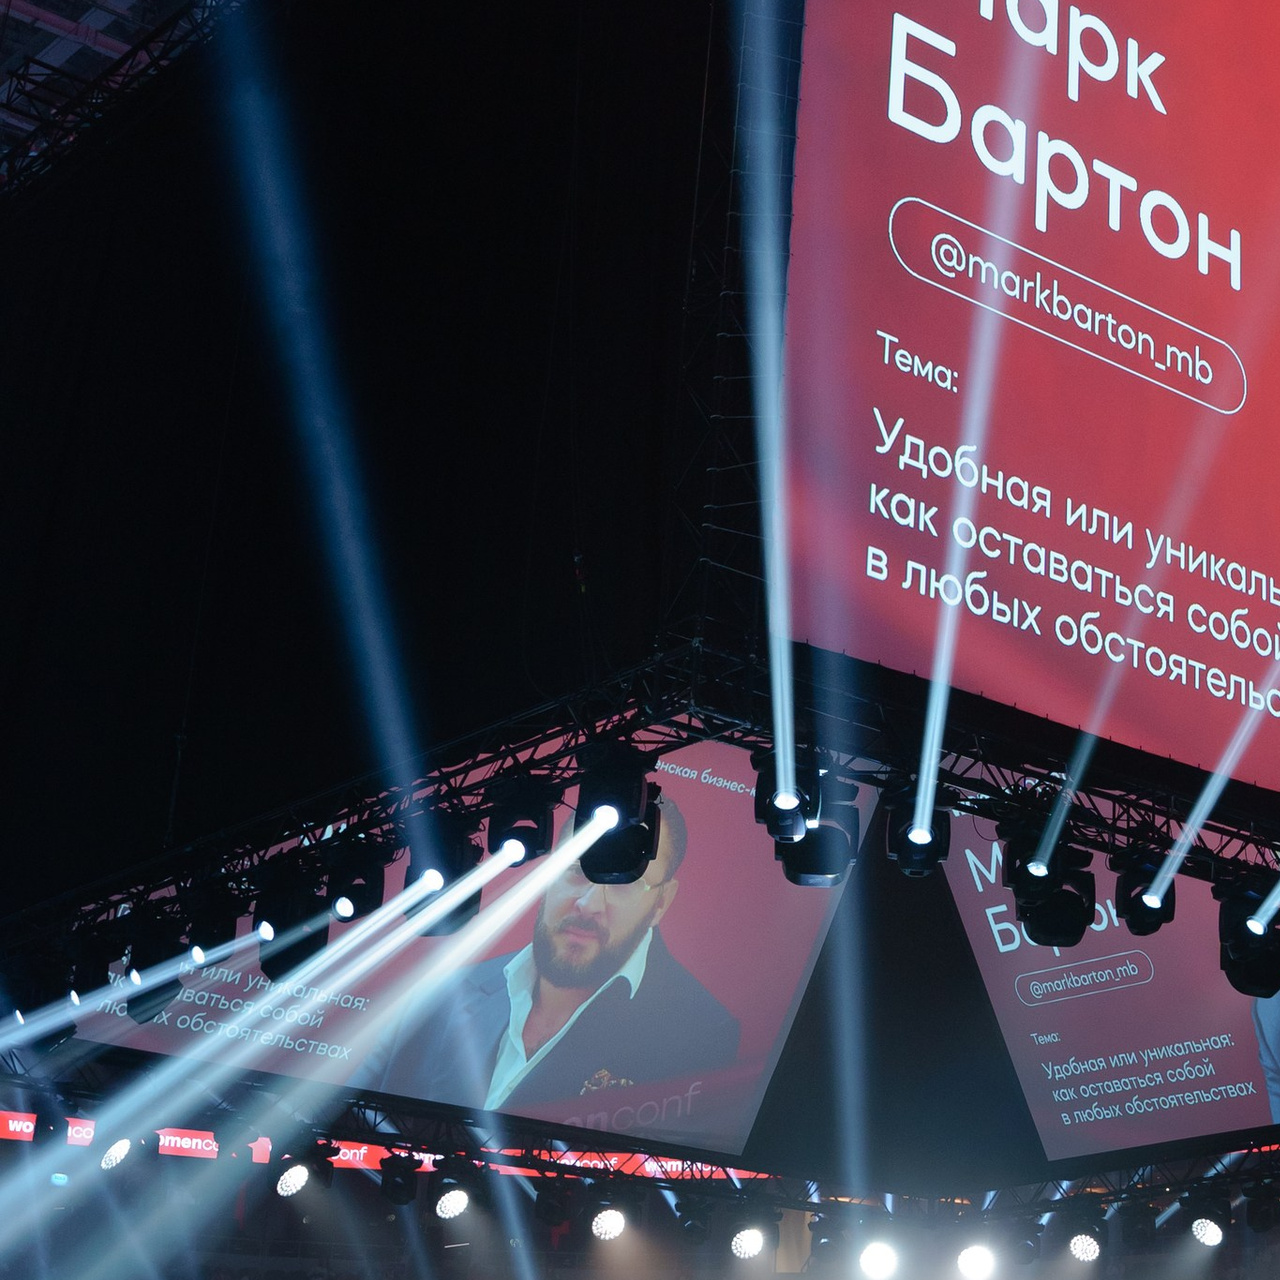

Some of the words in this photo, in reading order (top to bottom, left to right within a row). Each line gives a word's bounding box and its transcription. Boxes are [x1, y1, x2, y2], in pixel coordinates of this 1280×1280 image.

[887, 12, 1242, 291] Бартон
[930, 232, 1213, 385] @markbarton_mb
[876, 330, 960, 394] Тема:
[872, 407, 1052, 519] Удобная
[1065, 497, 1133, 550] или
[869, 483, 938, 537] как
[952, 516, 1175, 623] оставаться
[865, 546, 889, 581] в
[902, 559, 1041, 635] любых
[201, 966, 242, 986] или
[245, 973, 371, 1012] уникальная:
[1029, 960, 1139, 999] @markbarton_mb
[176, 1011, 352, 1061] обстоятельствах
[259, 999, 325, 1029] собой
[1030, 1031, 1062, 1046] Тема:
[1041, 1056, 1107, 1081] Удобная
[1108, 1052, 1138, 1069] или
[1139, 1033, 1235, 1067] уникальная:
[1052, 1086, 1078, 1103] как
[1079, 1072, 1164, 1099] оставаться
[1166, 1058, 1216, 1083] собой
[1060, 1113, 1071, 1126] в
[1074, 1102, 1123, 1125] любых
[1125, 1081, 1257, 1115] обстоятельствах
